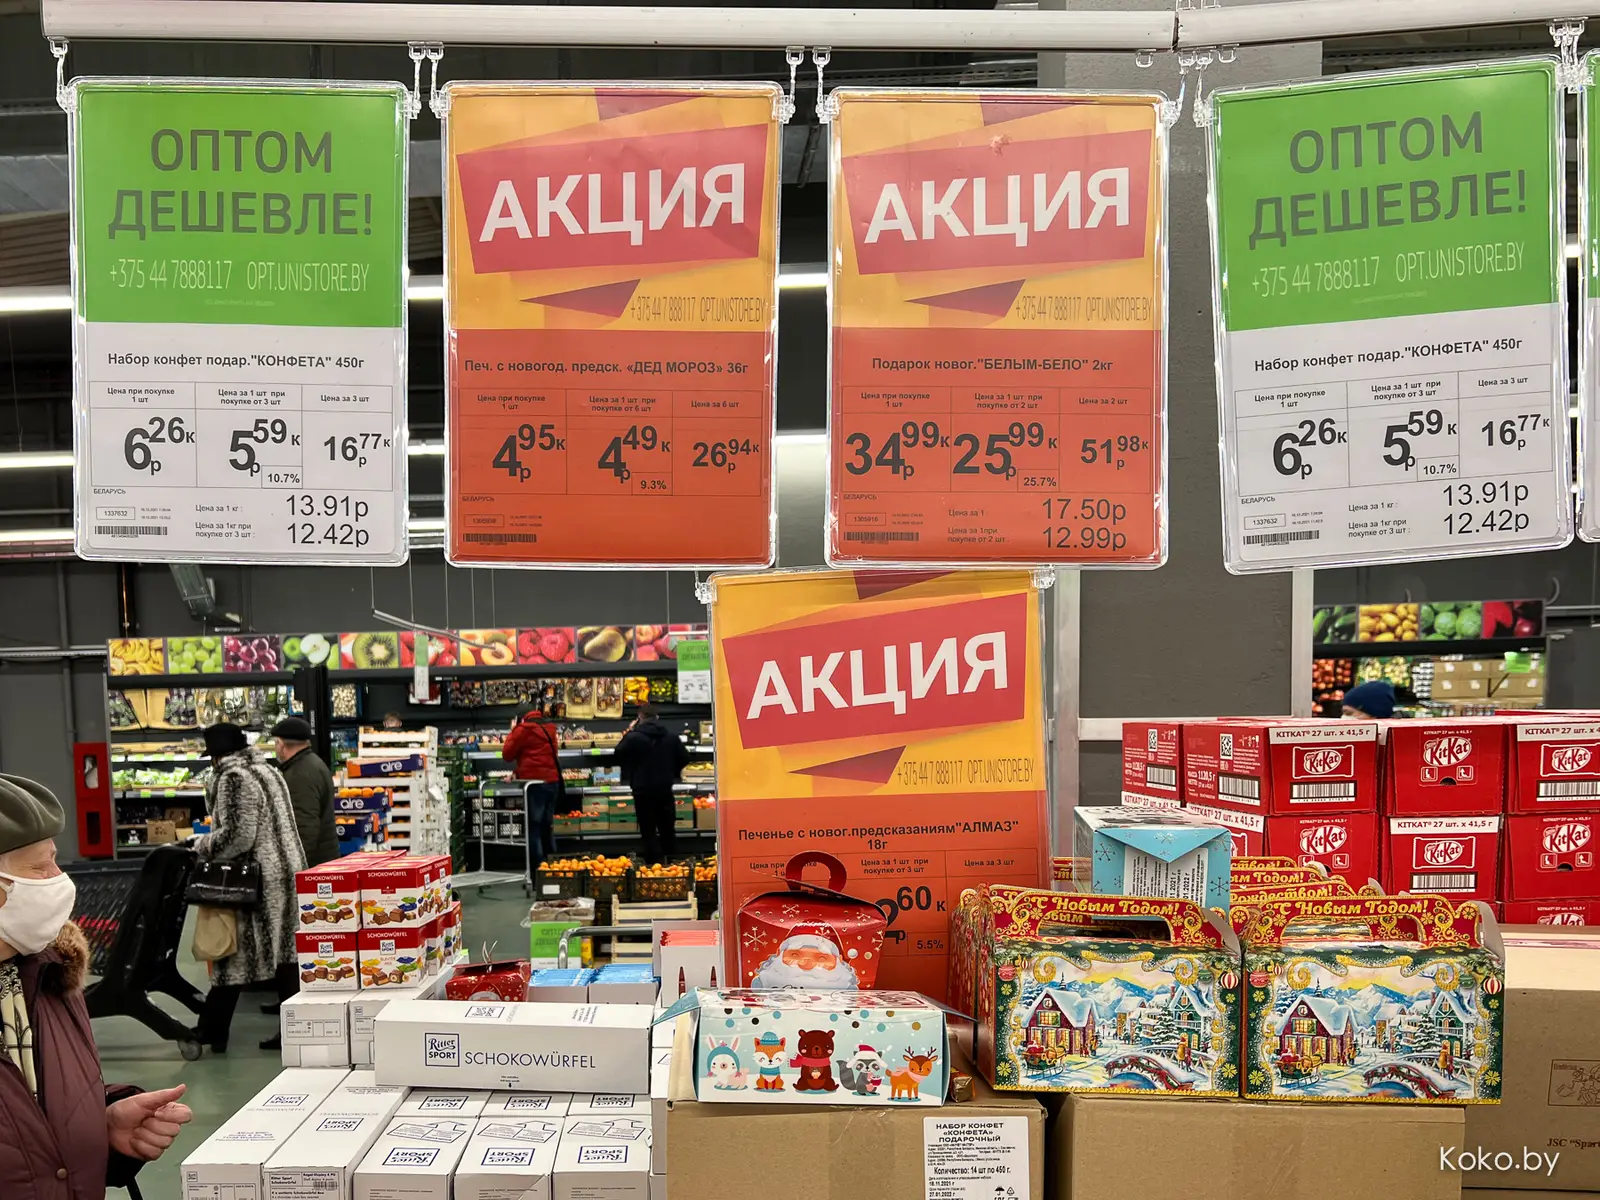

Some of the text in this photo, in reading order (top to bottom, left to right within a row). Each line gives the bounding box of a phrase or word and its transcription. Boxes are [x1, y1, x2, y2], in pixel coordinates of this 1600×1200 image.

[151, 129, 332, 173] ОПТОМ
[1290, 111, 1482, 174] ОПТОМ
[108, 189, 372, 240] ДЕШЕВЛЕ!
[479, 163, 745, 245] АКЦИЯ
[864, 167, 1129, 247] АКЦИЯ
[1249, 169, 1526, 250] ДЕШЕВЛЕ!
[109, 259, 369, 292] +375 44 7888117 OPT.UNISTORE.BY
[1252, 241, 1525, 297] +375 44 7888117 OPT.UNISTORE.BY
[108, 354, 149, 367] Набор
[154, 355, 202, 367] конфет
[336, 357, 364, 368] 450г
[872, 358, 930, 371] Подарок
[1092, 360, 1113, 372] 2кг
[1254, 358, 1299, 372] Набор
[1303, 352, 1352, 369] конфет
[1492, 338, 1522, 351] 450г
[464, 360, 748, 375] Печ. с новогод. предск. «ДЕД МОРОЗ» 36г
[107, 388, 126, 396] Цена
[144, 388, 175, 397] покупке
[218, 389, 237, 397] Цена
[271, 390, 285, 398] при
[220, 398, 250, 406] покупке
[321, 395, 339, 403] Цена
[268, 473, 300, 484] 10.7%
[1423, 463, 1457, 476] 10.7%
[640, 479, 667, 490] 9.3%
[1023, 477, 1057, 487] 25.7%
[1241, 496, 1275, 505] БЕЛАРУСЬ
[1442, 481, 1529, 508] 13.91р
[286, 495, 369, 520] 13.91р
[1042, 499, 1126, 524] 17.50р
[1443, 510, 1529, 536] 12.42р
[286, 523, 369, 547] 12.42р
[1042, 526, 1127, 551] 12.99р
[746, 631, 1007, 720] АКЦИЯ
[1308, 750, 1338, 774] KitKat
[1430, 737, 1469, 765] KitKat
[1557, 747, 1587, 771] KitKat
[739, 829, 794, 841] Печенье
[798, 830, 805, 838] с
[867, 839, 888, 850] 18г
[1306, 826, 1344, 854] KitKat
[1550, 824, 1587, 852] KitKat
[1429, 841, 1461, 864] KitKat
[1052, 898, 1114, 913] Новым
[1119, 900, 1180, 915] Годом!
[1295, 901, 1361, 914] Новым
[1365, 899, 1428, 914] Годом!
[917, 939, 944, 950] 5.5%
[428, 1038, 455, 1052] Ritter
[465, 1051, 595, 1068] SCHOKOWÜRFEL
[1547, 1138, 1567, 1147] JSC
[934, 1167, 969, 1175] Количество:
[971, 1166, 977, 1174] 14
[996, 1166, 1006, 1174] 450
